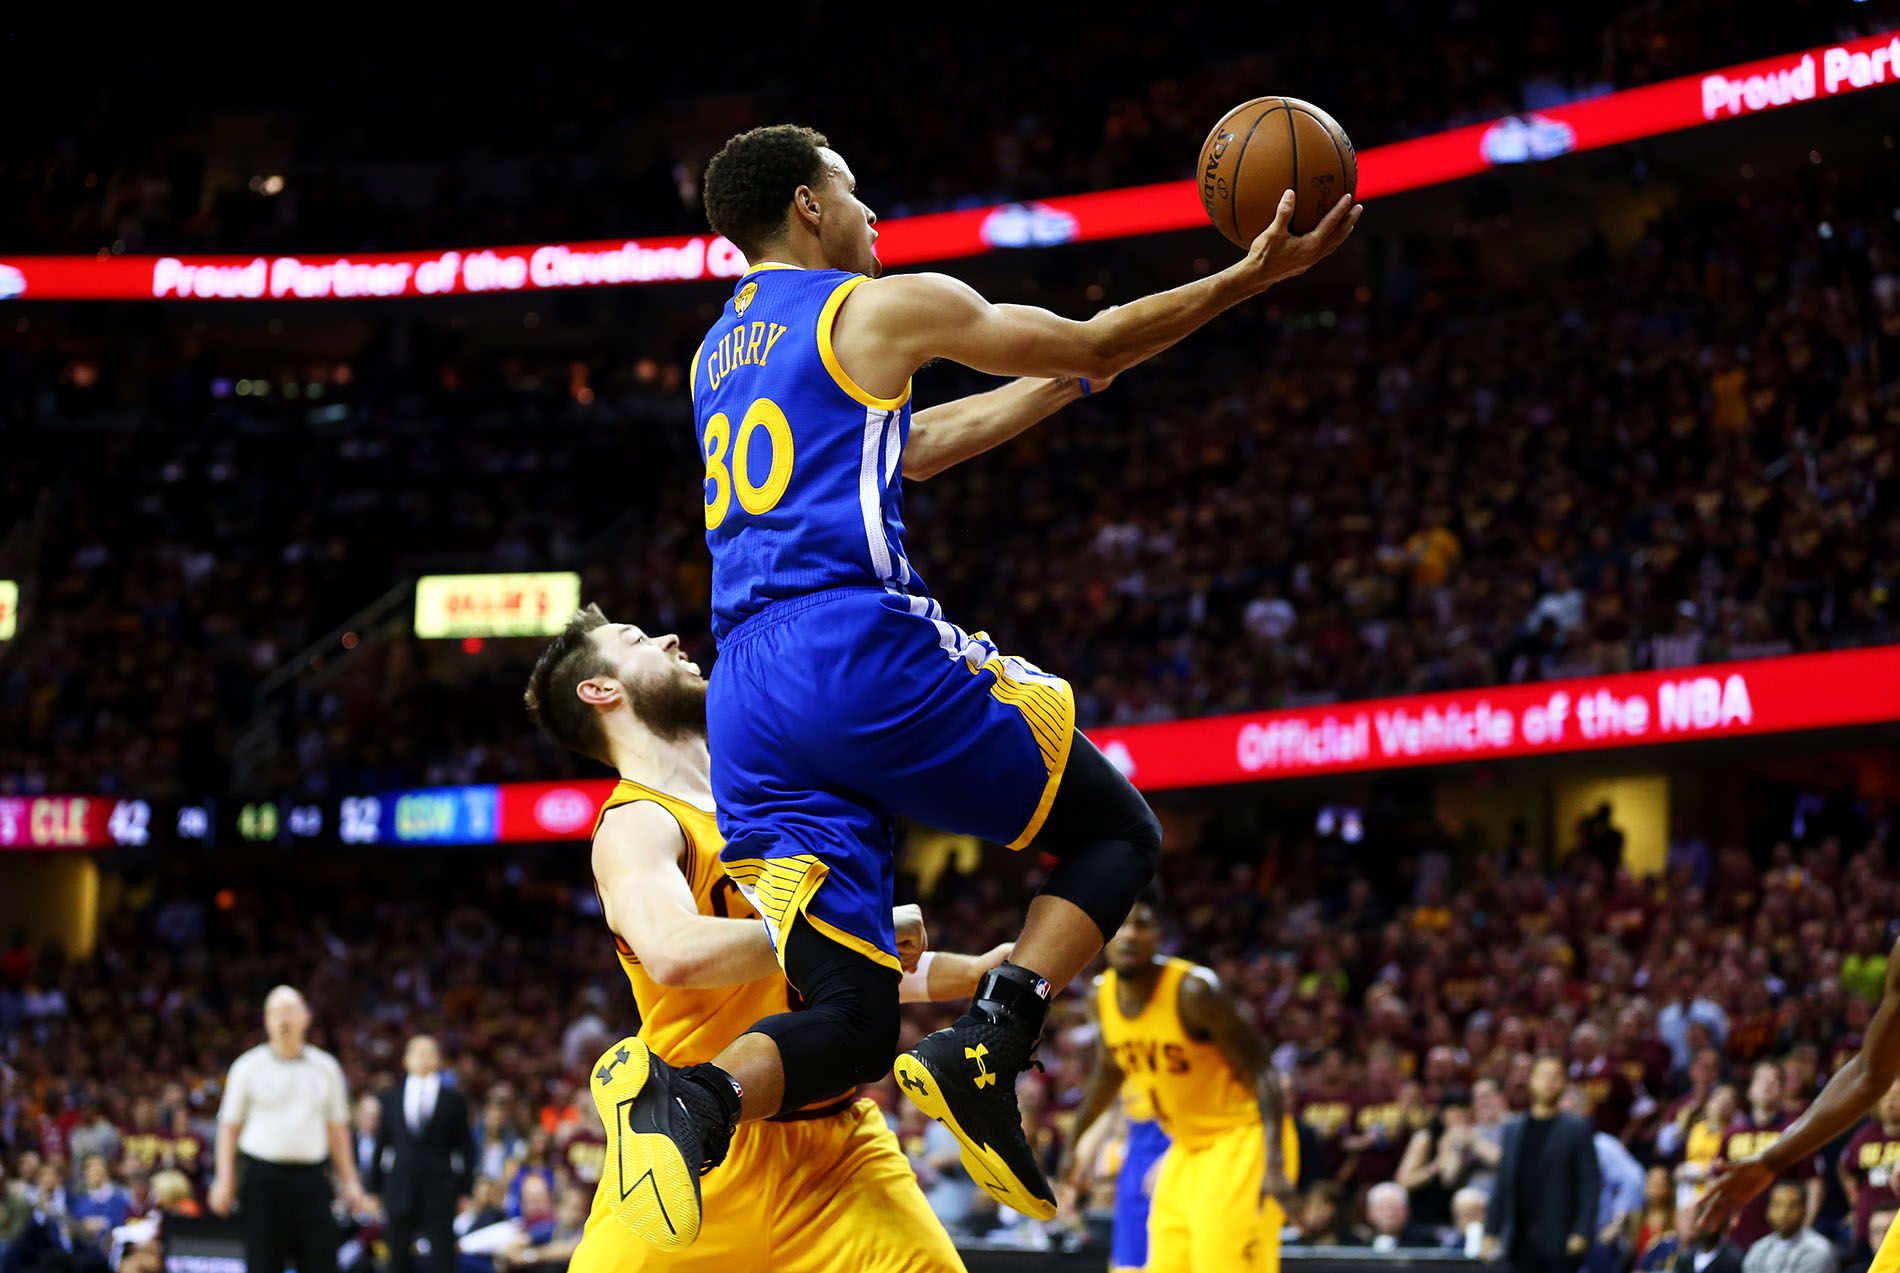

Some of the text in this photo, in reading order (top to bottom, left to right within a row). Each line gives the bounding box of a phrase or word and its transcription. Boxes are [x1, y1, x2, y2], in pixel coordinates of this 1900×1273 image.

[1702, 54, 1816, 120] Proud
[152, 256, 268, 299] Proud
[270, 256, 414, 299] Partner
[414, 251, 462, 295] of
[463, 249, 528, 292] the
[530, 237, 705, 287] Cleveland
[708, 321, 788, 391] CURRY
[703, 397, 795, 531] 30
[1236, 673, 1754, 772] Official Vehicle of the NBA
[31, 798, 90, 846] CLE
[107, 798, 151, 847] 42
[339, 796, 382, 845] 52
